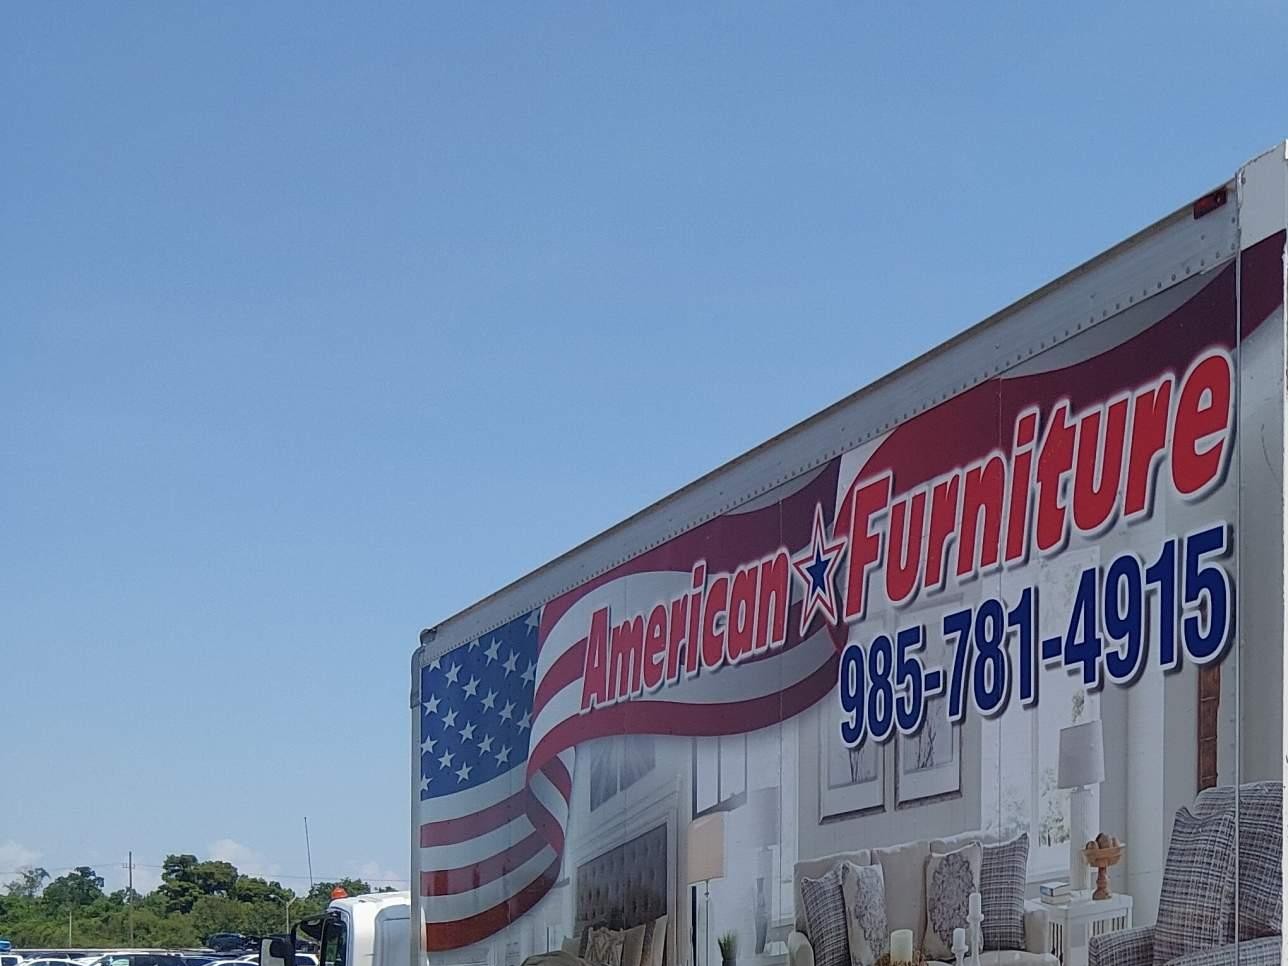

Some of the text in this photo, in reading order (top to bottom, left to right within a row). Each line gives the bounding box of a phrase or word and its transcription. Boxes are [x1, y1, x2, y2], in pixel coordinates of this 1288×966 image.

[578, 347, 1236, 713] American Furniture
[840, 525, 1232, 749] 985-781-4915
